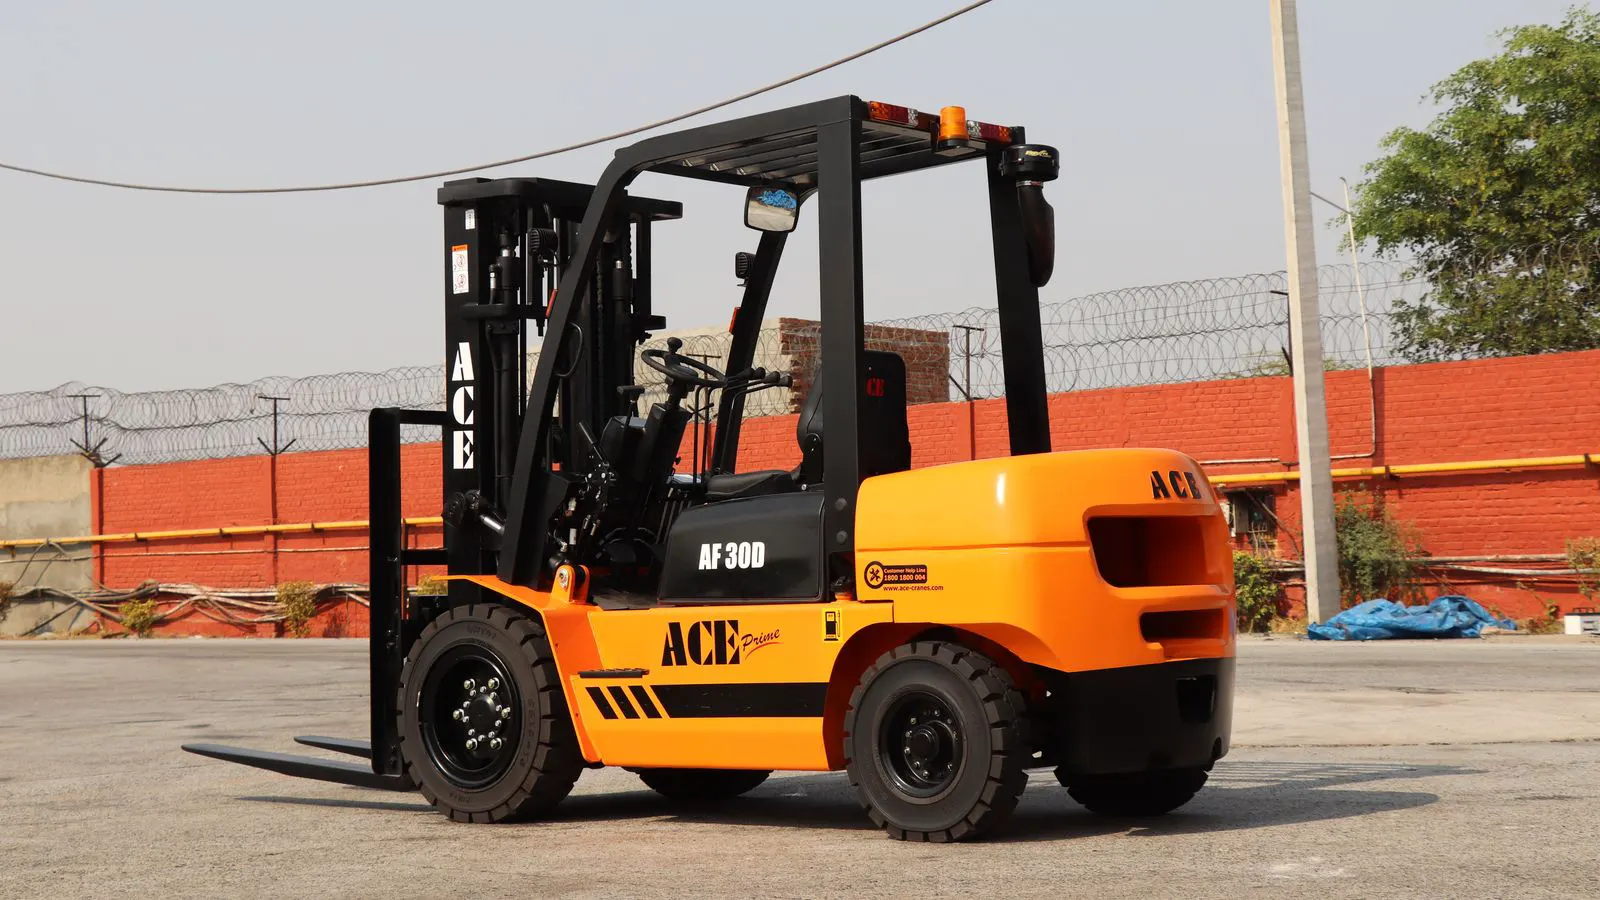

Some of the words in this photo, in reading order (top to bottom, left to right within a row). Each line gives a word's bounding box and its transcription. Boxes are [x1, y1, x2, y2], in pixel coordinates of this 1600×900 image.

[865, 378, 885, 397] CE
[451, 341, 475, 470] ACE
[1150, 470, 1201, 499] ACE
[698, 543, 722, 570] AF
[725, 541, 765, 569] 30D
[661, 620, 740, 666] ACE
[741, 629, 780, 652] Prime
